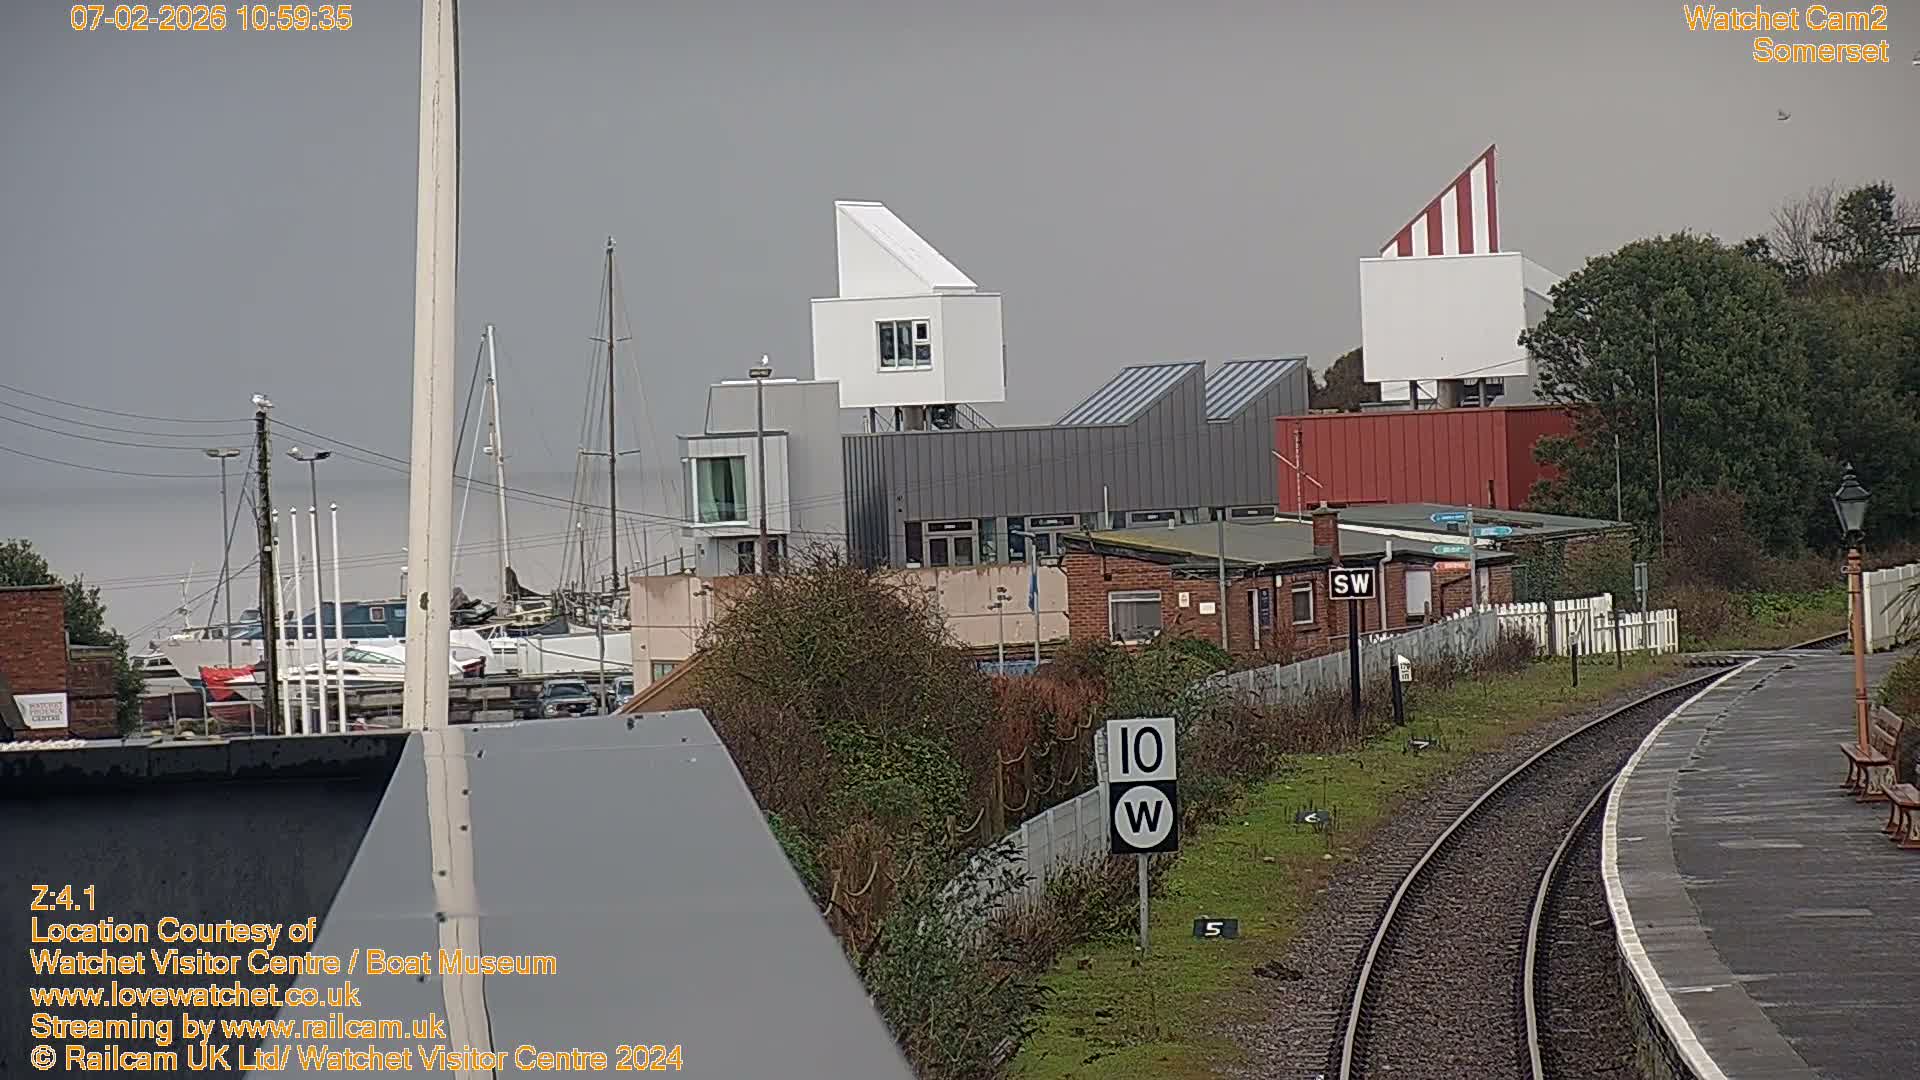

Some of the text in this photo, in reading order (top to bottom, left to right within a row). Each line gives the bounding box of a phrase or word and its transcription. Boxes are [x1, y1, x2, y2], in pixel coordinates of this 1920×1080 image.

[1334, 573, 1370, 594] SW
[1121, 726, 1163, 775] 10
[1124, 800, 1163, 833] W
[1204, 921, 1224, 936] 5
